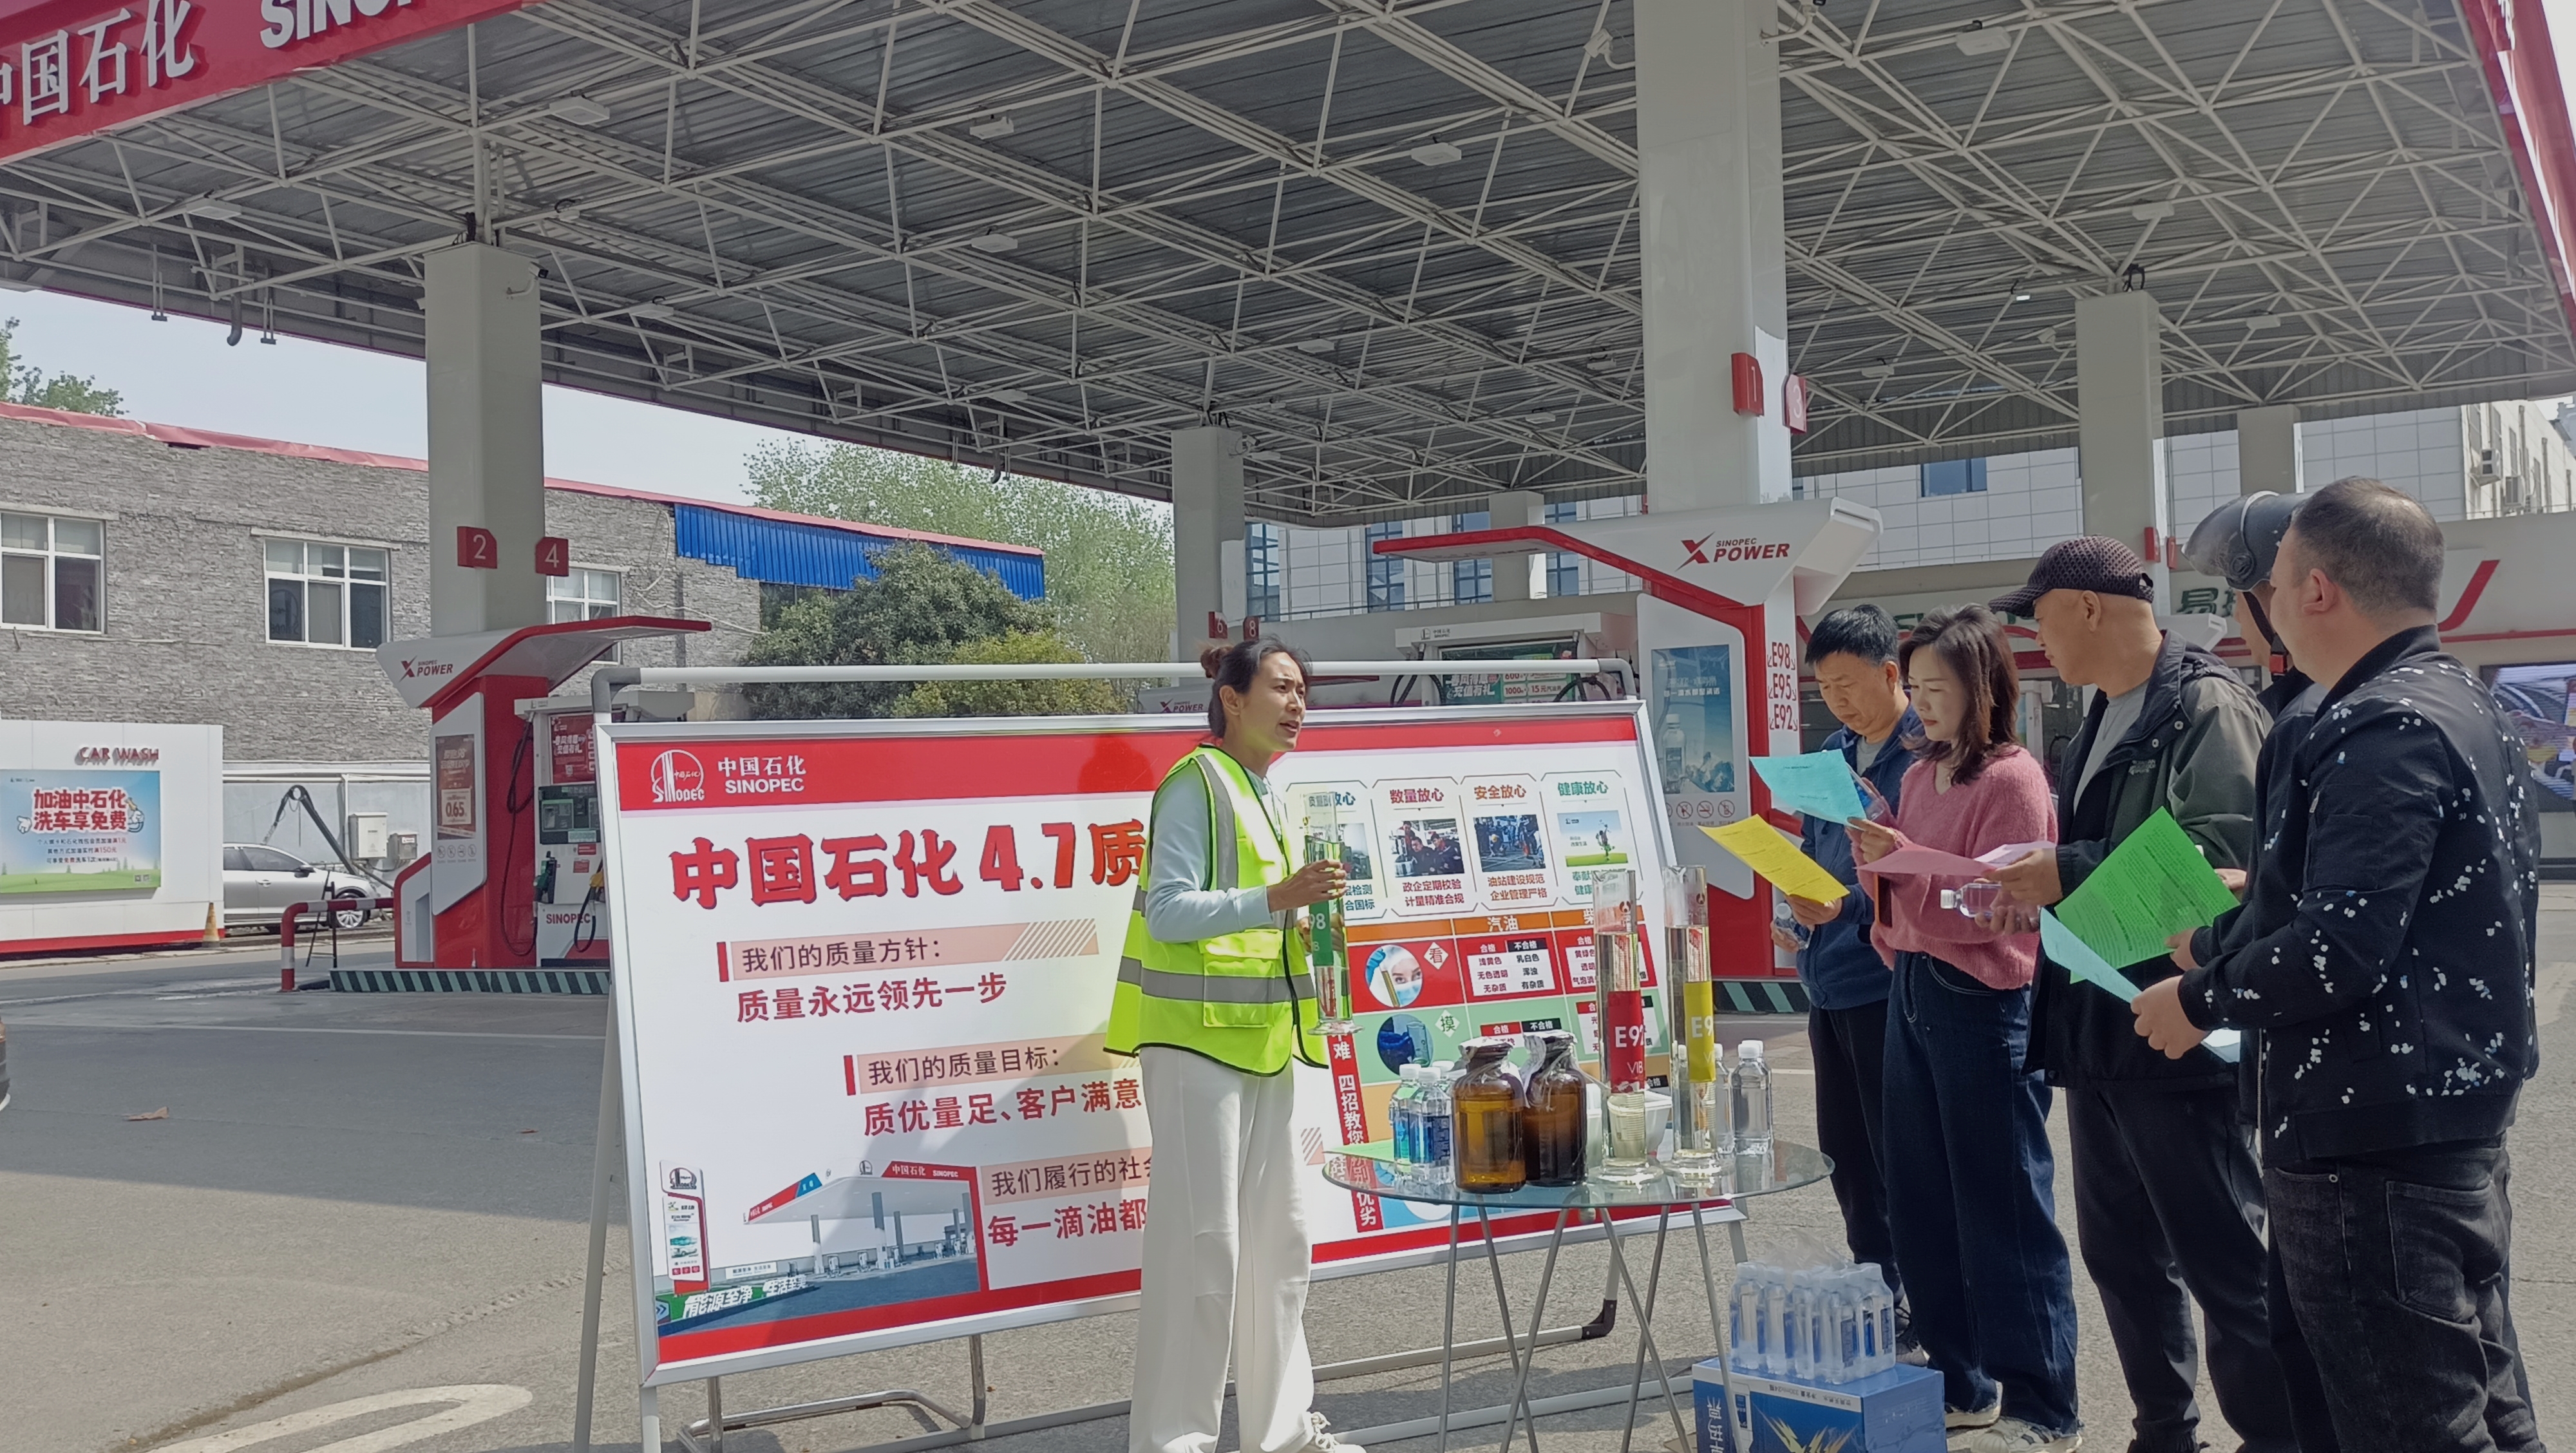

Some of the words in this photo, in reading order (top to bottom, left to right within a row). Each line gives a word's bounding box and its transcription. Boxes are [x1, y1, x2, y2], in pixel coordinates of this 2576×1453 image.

[1750, 366, 1757, 403] 1
[1792, 385, 1803, 419] 3
[472, 535, 486, 560] 2
[1716, 538, 1757, 547] SINOPEC
[544, 544, 560, 568] 4
[1713, 543, 1790, 562] POWER
[1217, 617, 1224, 633] 6
[1249, 620, 1256, 637] 8
[1772, 642, 1791, 668] E98
[417, 664, 453, 677] POWER
[1773, 673, 1792, 699] E95
[1173, 703, 1204, 712] POWER
[1774, 705, 1794, 730] E92
[79, 747, 110, 760] CAR
[117, 748, 159, 760] WASH
[718, 755, 806, 777] 中国石化
[725, 778, 805, 793] SINOPEC
[1474, 784, 1527, 801] 安全放心
[1557, 781, 1609, 797] 健康放心
[33, 788, 127, 810] 加油中石化
[1389, 788, 1444, 804] 数量放心
[446, 802, 464, 817] 0.65
[33, 810, 127, 831] 洗车享免费
[1402, 878, 1462, 892] 政企定期校验
[1488, 873, 1545, 887] 油站建设规范
[1405, 893, 1464, 907] 计量精准合规
[1490, 888, 1548, 902] 企业管理严格
[1345, 899, 1375, 911] 合国标
[1487, 915, 1519, 932] 汽油
[1480, 944, 1495, 953] 合格
[1514, 940, 1537, 950] 不合格
[1577, 936, 1592, 945] 合格
[741, 935, 942, 974] 我们的质量方针：
[1429, 947, 1443, 964] 看
[1517, 953, 1539, 963] 乳白色
[1477, 969, 1508, 980] 无色透明
[1483, 983, 1507, 992] 无杂质
[1521, 980, 1544, 989] 有杂质
[737, 973, 1008, 1023] 质量永远领先一步
[1440, 1016, 1456, 1032] 摸
[1493, 1024, 1509, 1034] 合格
[1530, 1021, 1553, 1030] 不合格
[867, 1047, 1059, 1087] 我们的质量目标：
[864, 1078, 1142, 1137] 质优量足、客户满意
[893, 1163, 926, 1177] 中国石化
[988, 1198, 1146, 1248] 每一滴油都
[683, 1286, 752, 1319] 能源至净
